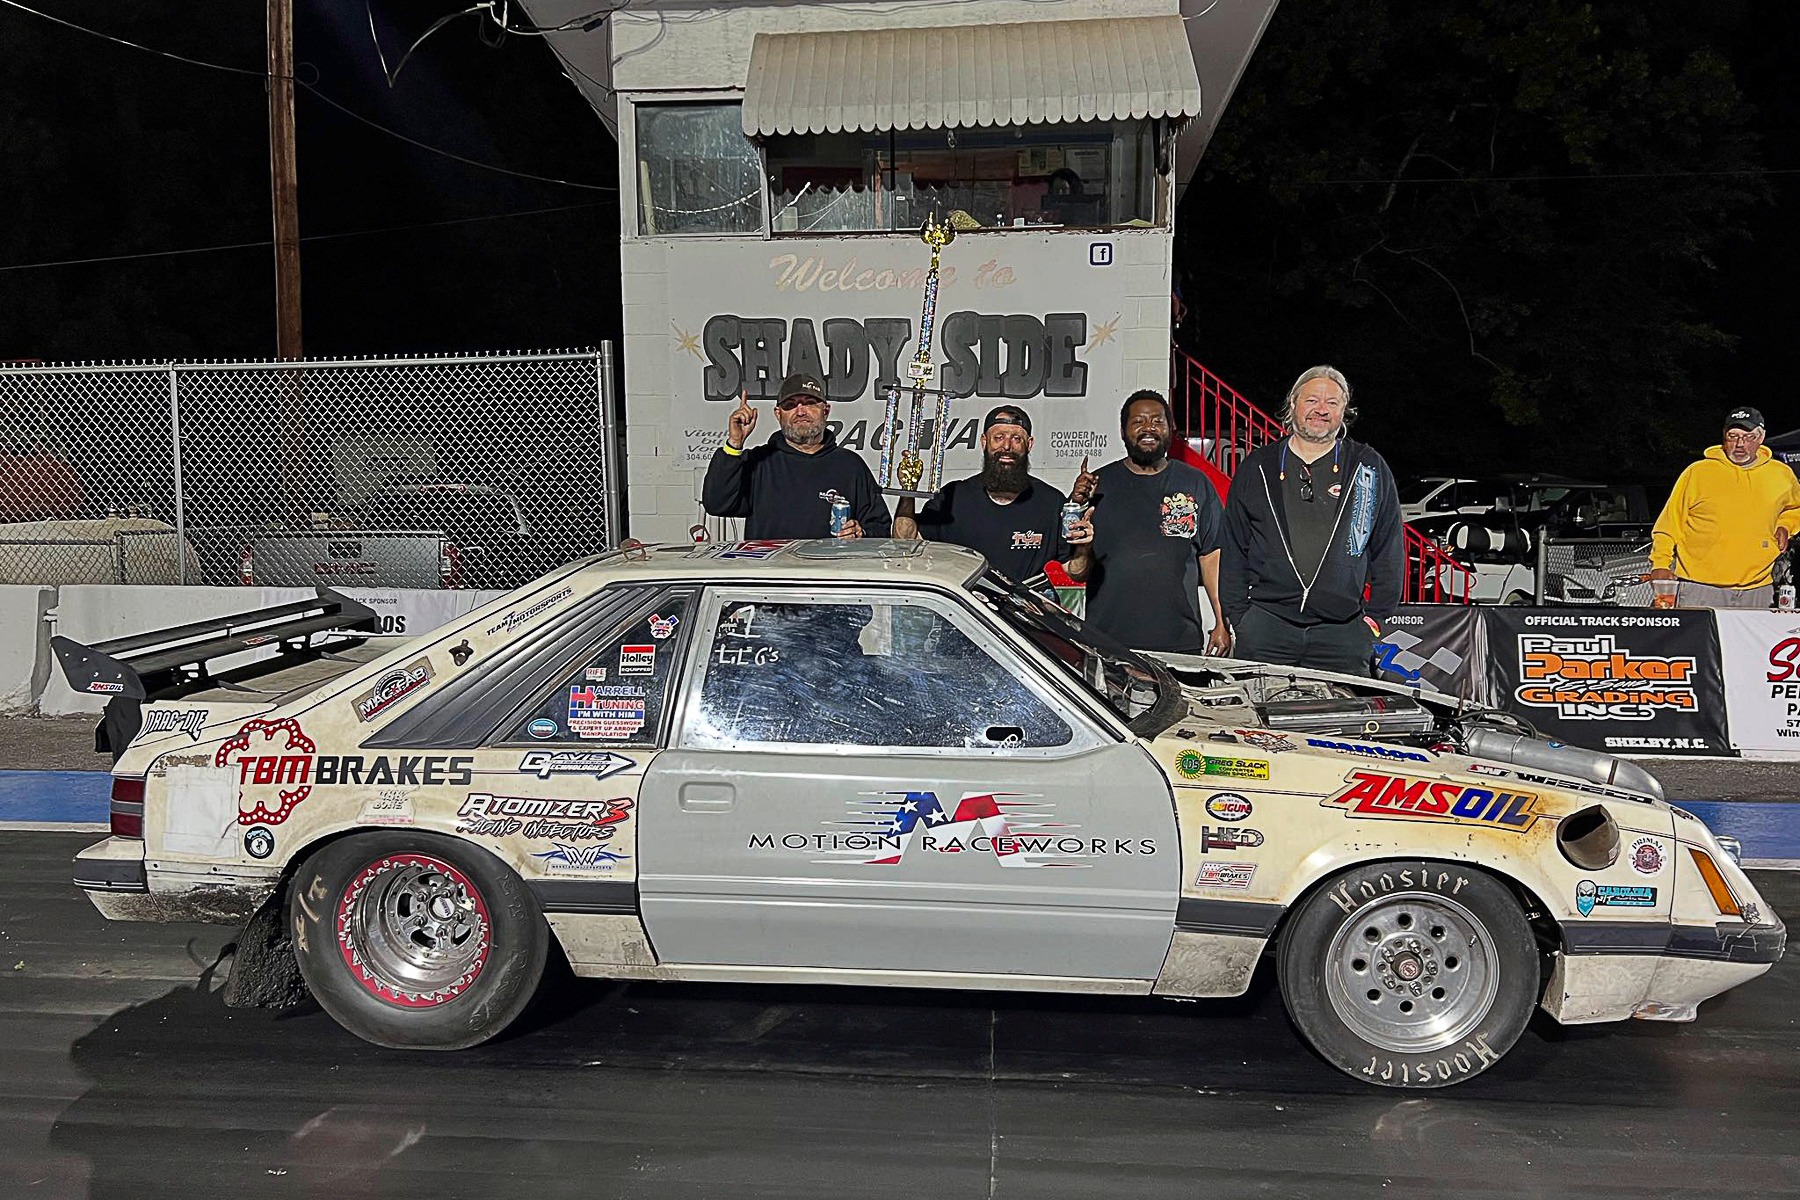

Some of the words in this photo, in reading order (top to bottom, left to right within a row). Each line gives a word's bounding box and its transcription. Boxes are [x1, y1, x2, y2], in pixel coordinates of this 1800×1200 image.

[974, 258, 1018, 289] to
[703, 314, 911, 401] SHADY
[941, 311, 1088, 399] SIDE
[1051, 431, 1089, 440] POWDER
[1051, 440, 1090, 448] COATING
[512, 588, 572, 624] MOTORSPORTS
[1525, 616, 1578, 626] OFFICIAL
[1580, 617, 1619, 626] TRACK
[1622, 617, 1680, 627] SPONSOR
[1523, 638, 1609, 654] Paul
[621, 653, 654, 664] Holley
[1525, 653, 1692, 680] Parker
[91, 683, 123, 691] AMSOIL
[577, 710, 591, 718] I'M
[593, 710, 616, 718] WITH
[595, 701, 644, 709] TUNING
[237, 756, 313, 785] TBM
[315, 756, 474, 785] BRAKES
[1209, 758, 1233, 767] GREG
[1235, 760, 1266, 769] SLACK
[1333, 771, 1530, 827] AMSOIL
[458, 794, 607, 820] ATOMIZER
[594, 798, 634, 826] 3
[523, 821, 615, 841] INJECTORS
[749, 833, 900, 851] MOTION
[922, 836, 1158, 855] RACEWORKS
[1631, 837, 1663, 851] PRIMAL
[1328, 863, 1470, 915] Hoosier
